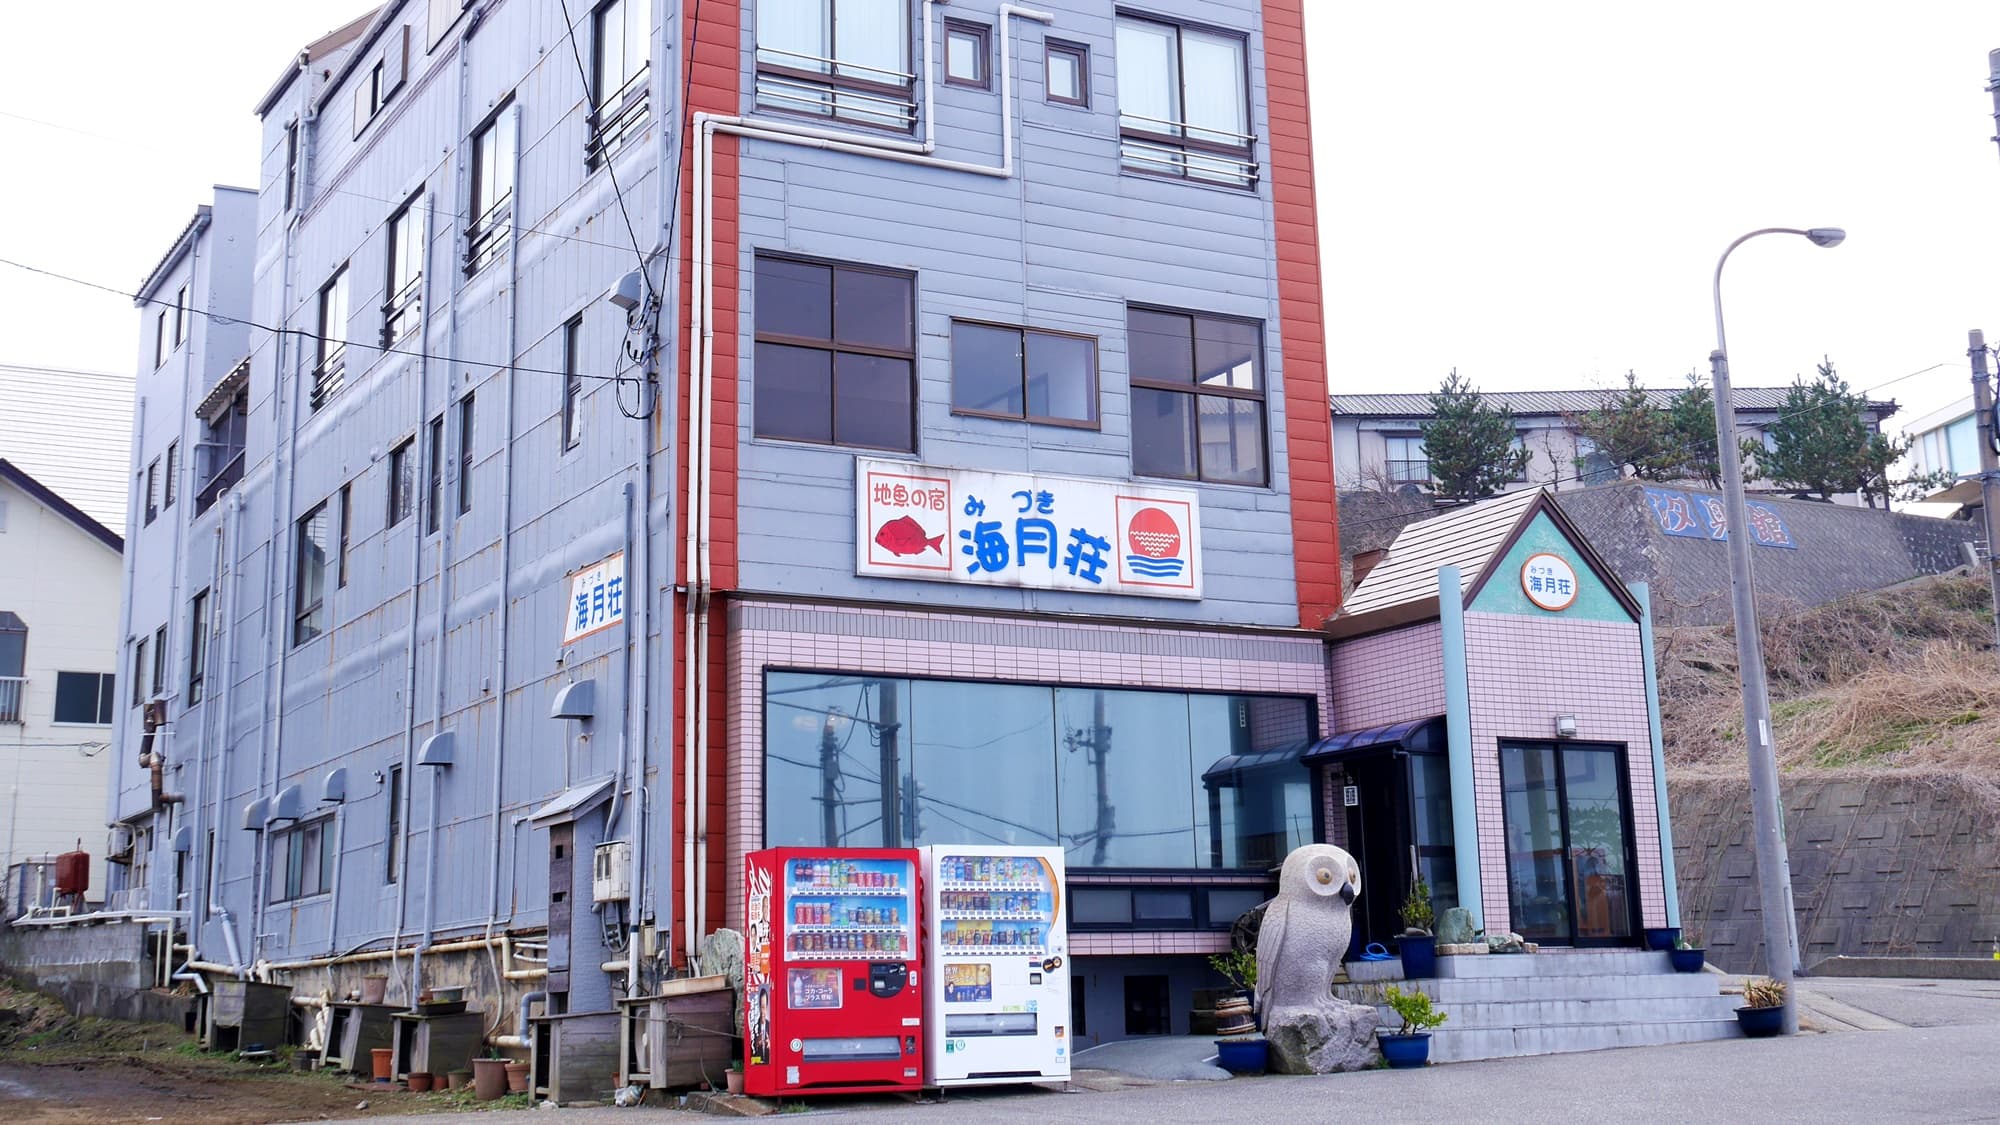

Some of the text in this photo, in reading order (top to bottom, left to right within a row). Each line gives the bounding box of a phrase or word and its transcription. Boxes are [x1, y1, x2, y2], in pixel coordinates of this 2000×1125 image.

[873, 482, 946, 511] 地魚の宿
[959, 517, 1111, 584] 海月荘
[574, 576, 622, 631] 海月荘
[1529, 575, 1572, 595] 海月荘
